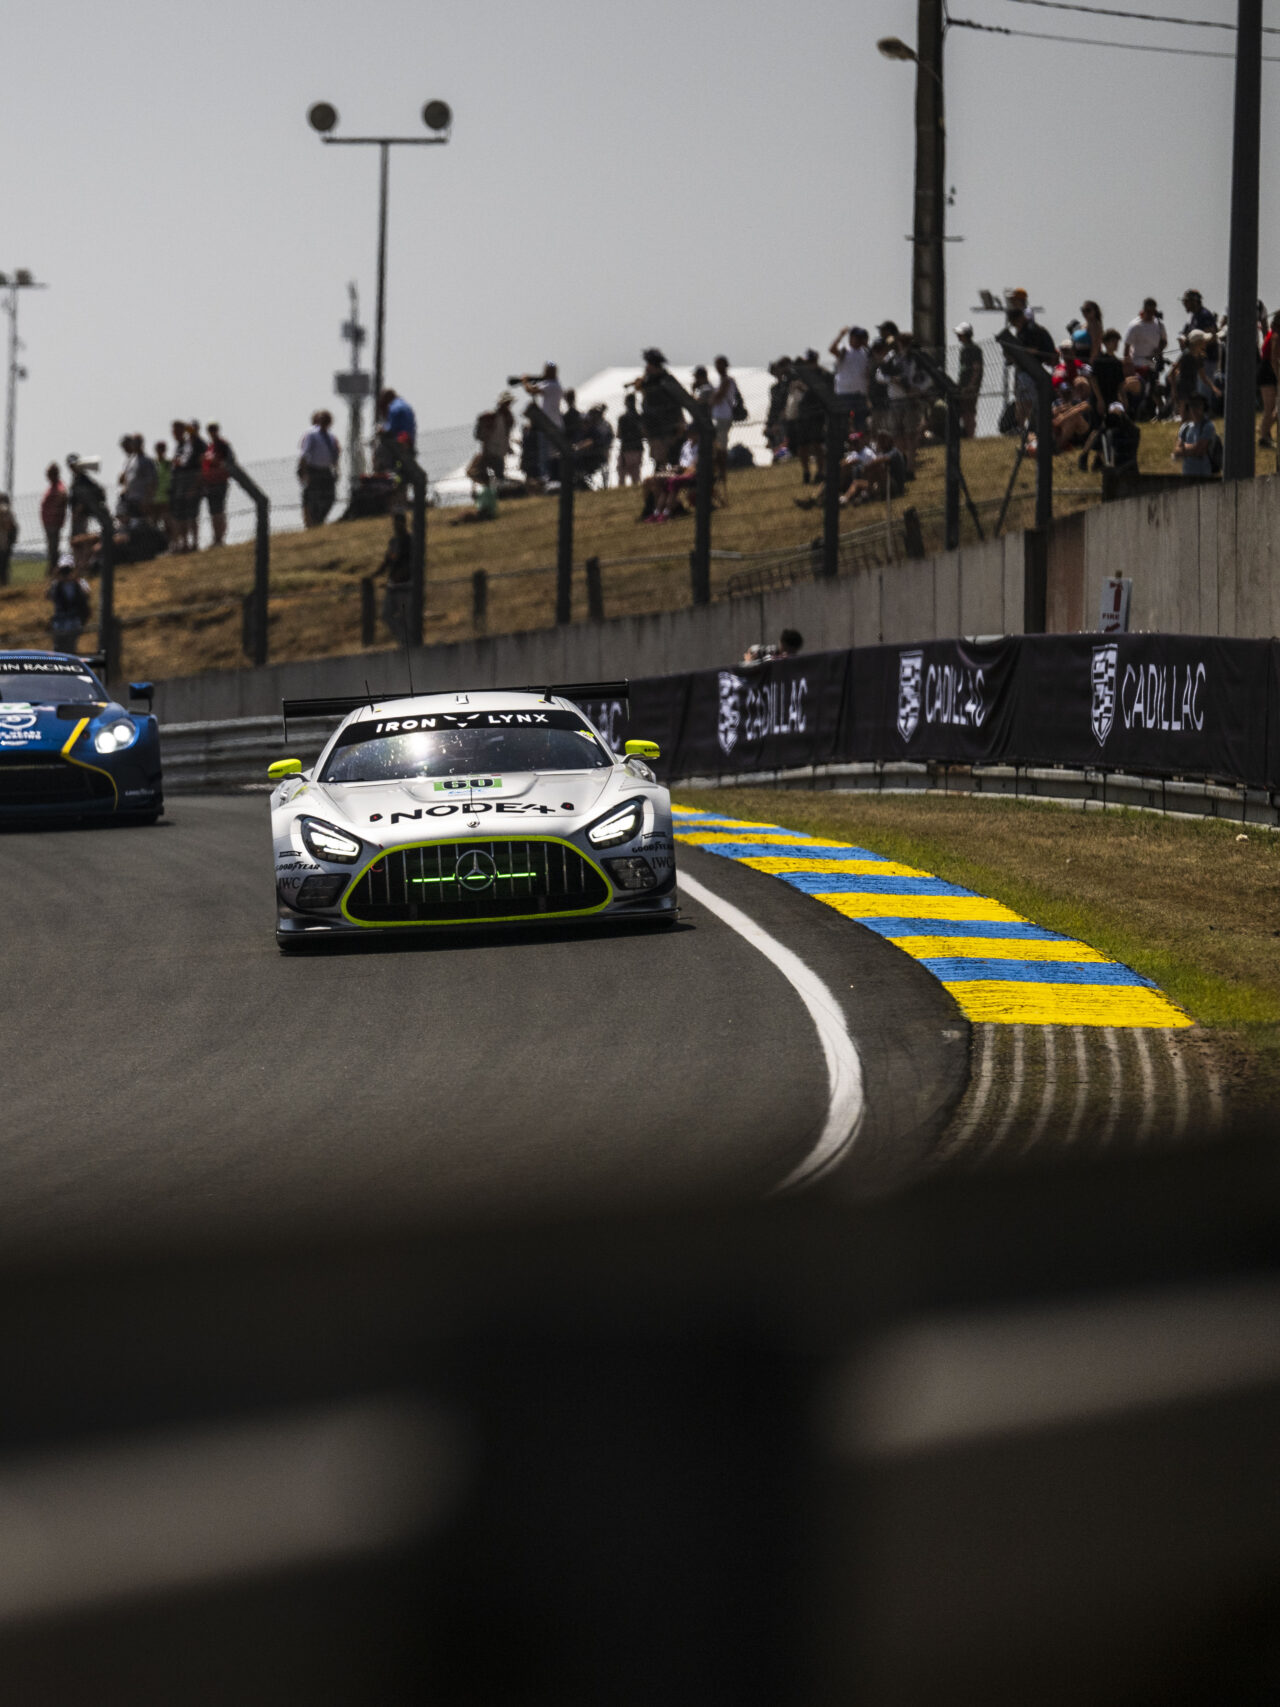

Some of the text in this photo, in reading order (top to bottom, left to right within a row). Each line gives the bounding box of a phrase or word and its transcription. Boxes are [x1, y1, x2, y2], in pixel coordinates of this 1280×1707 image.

[23, 663, 84, 673] RACING
[925, 663, 986, 727] CADILLAC
[1122, 662, 1206, 730] CADILLAC
[745, 677, 808, 740] CADILLAC
[376, 713, 549, 733] IRON LYNX
[443, 778, 493, 789] 60
[390, 802, 556, 825] NODE4
[652, 856, 673, 869] IWC
[278, 877, 300, 889] IWC
